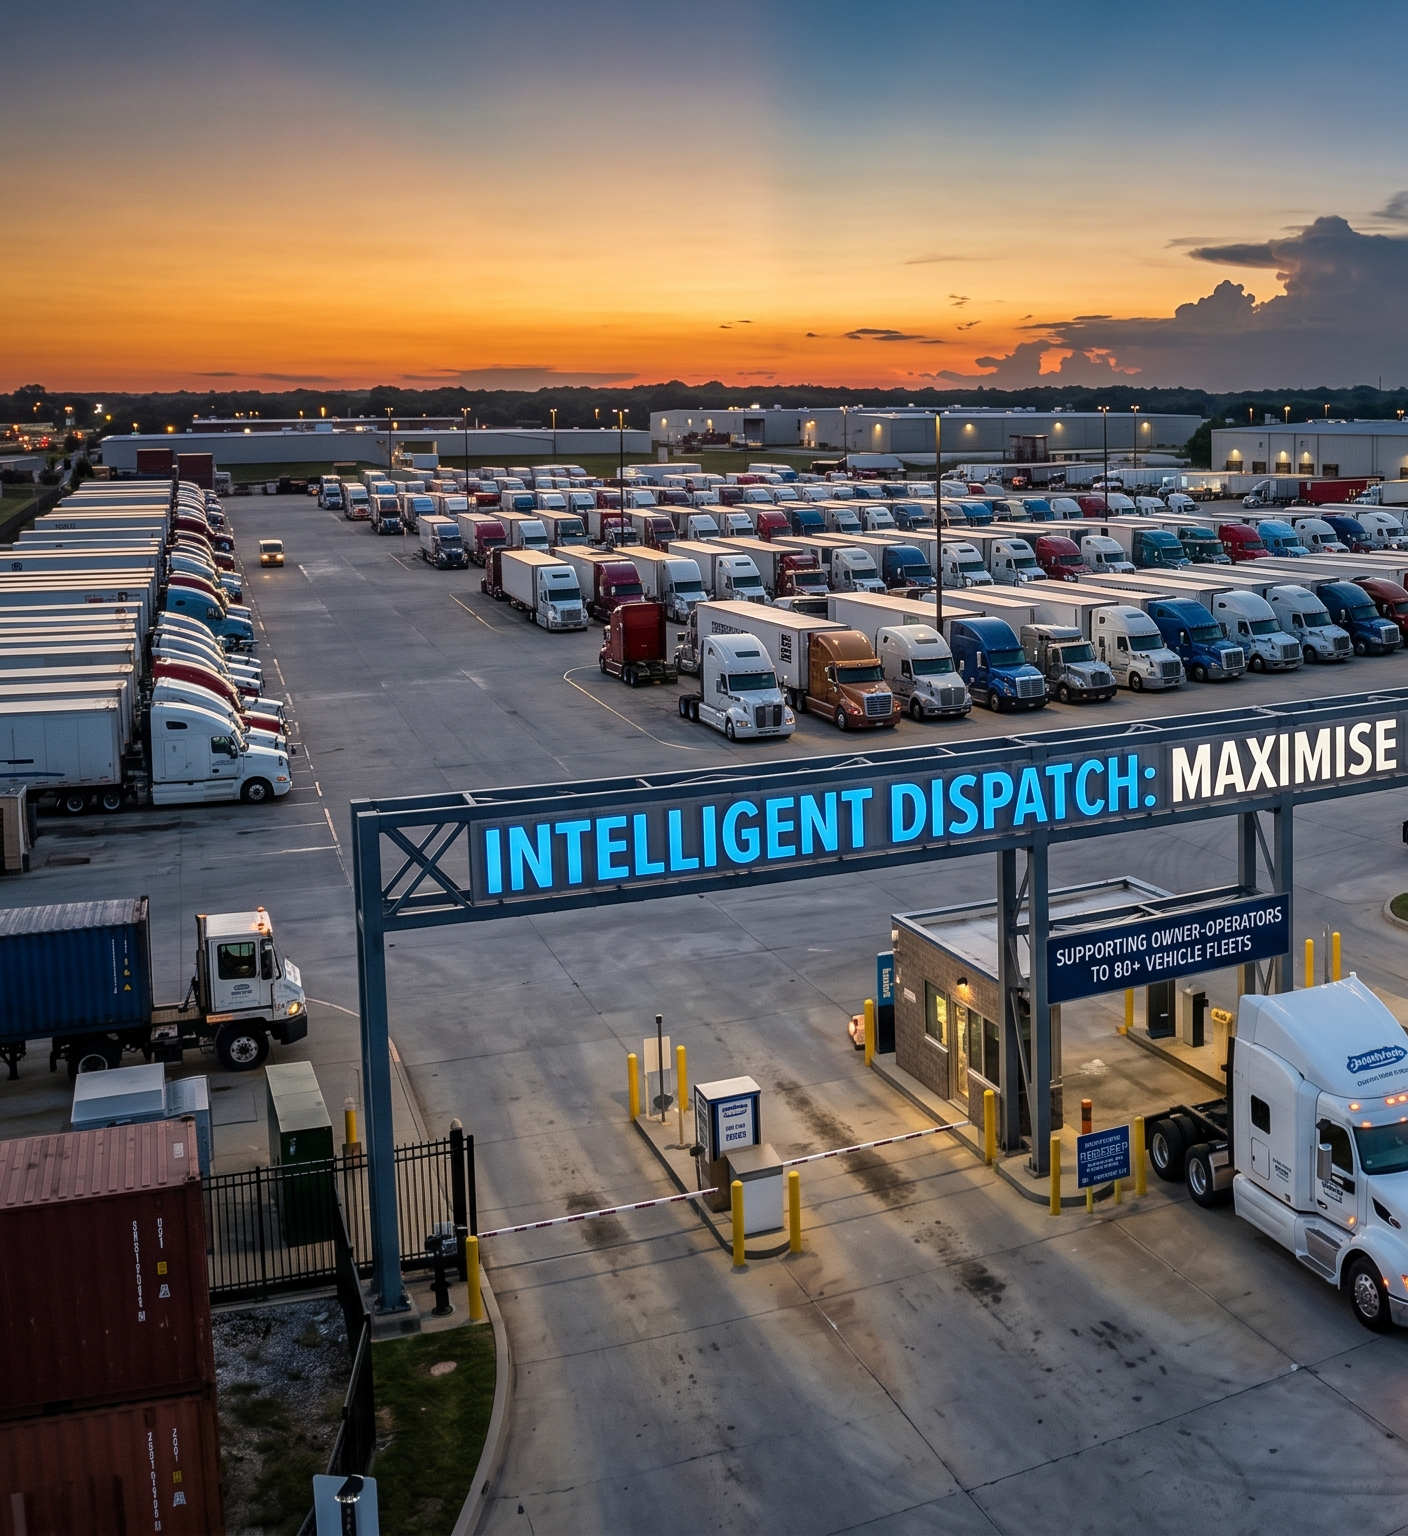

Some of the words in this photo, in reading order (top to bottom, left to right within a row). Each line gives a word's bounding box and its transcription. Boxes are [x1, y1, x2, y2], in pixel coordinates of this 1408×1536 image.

[484, 786, 875, 895] INTELLIGENT
[890, 753, 1158, 844] DISPATCH:
[1171, 717, 1399, 804] MAXIMISE
[1055, 934, 1148, 968] SUPPORTING
[1150, 905, 1283, 949] OWNER-OPERATORS
[1090, 964, 1110, 984] TO
[1113, 959, 1142, 979] 80+
[1144, 944, 1203, 972] VEHICLE
[1205, 934, 1253, 959] FLEETS
